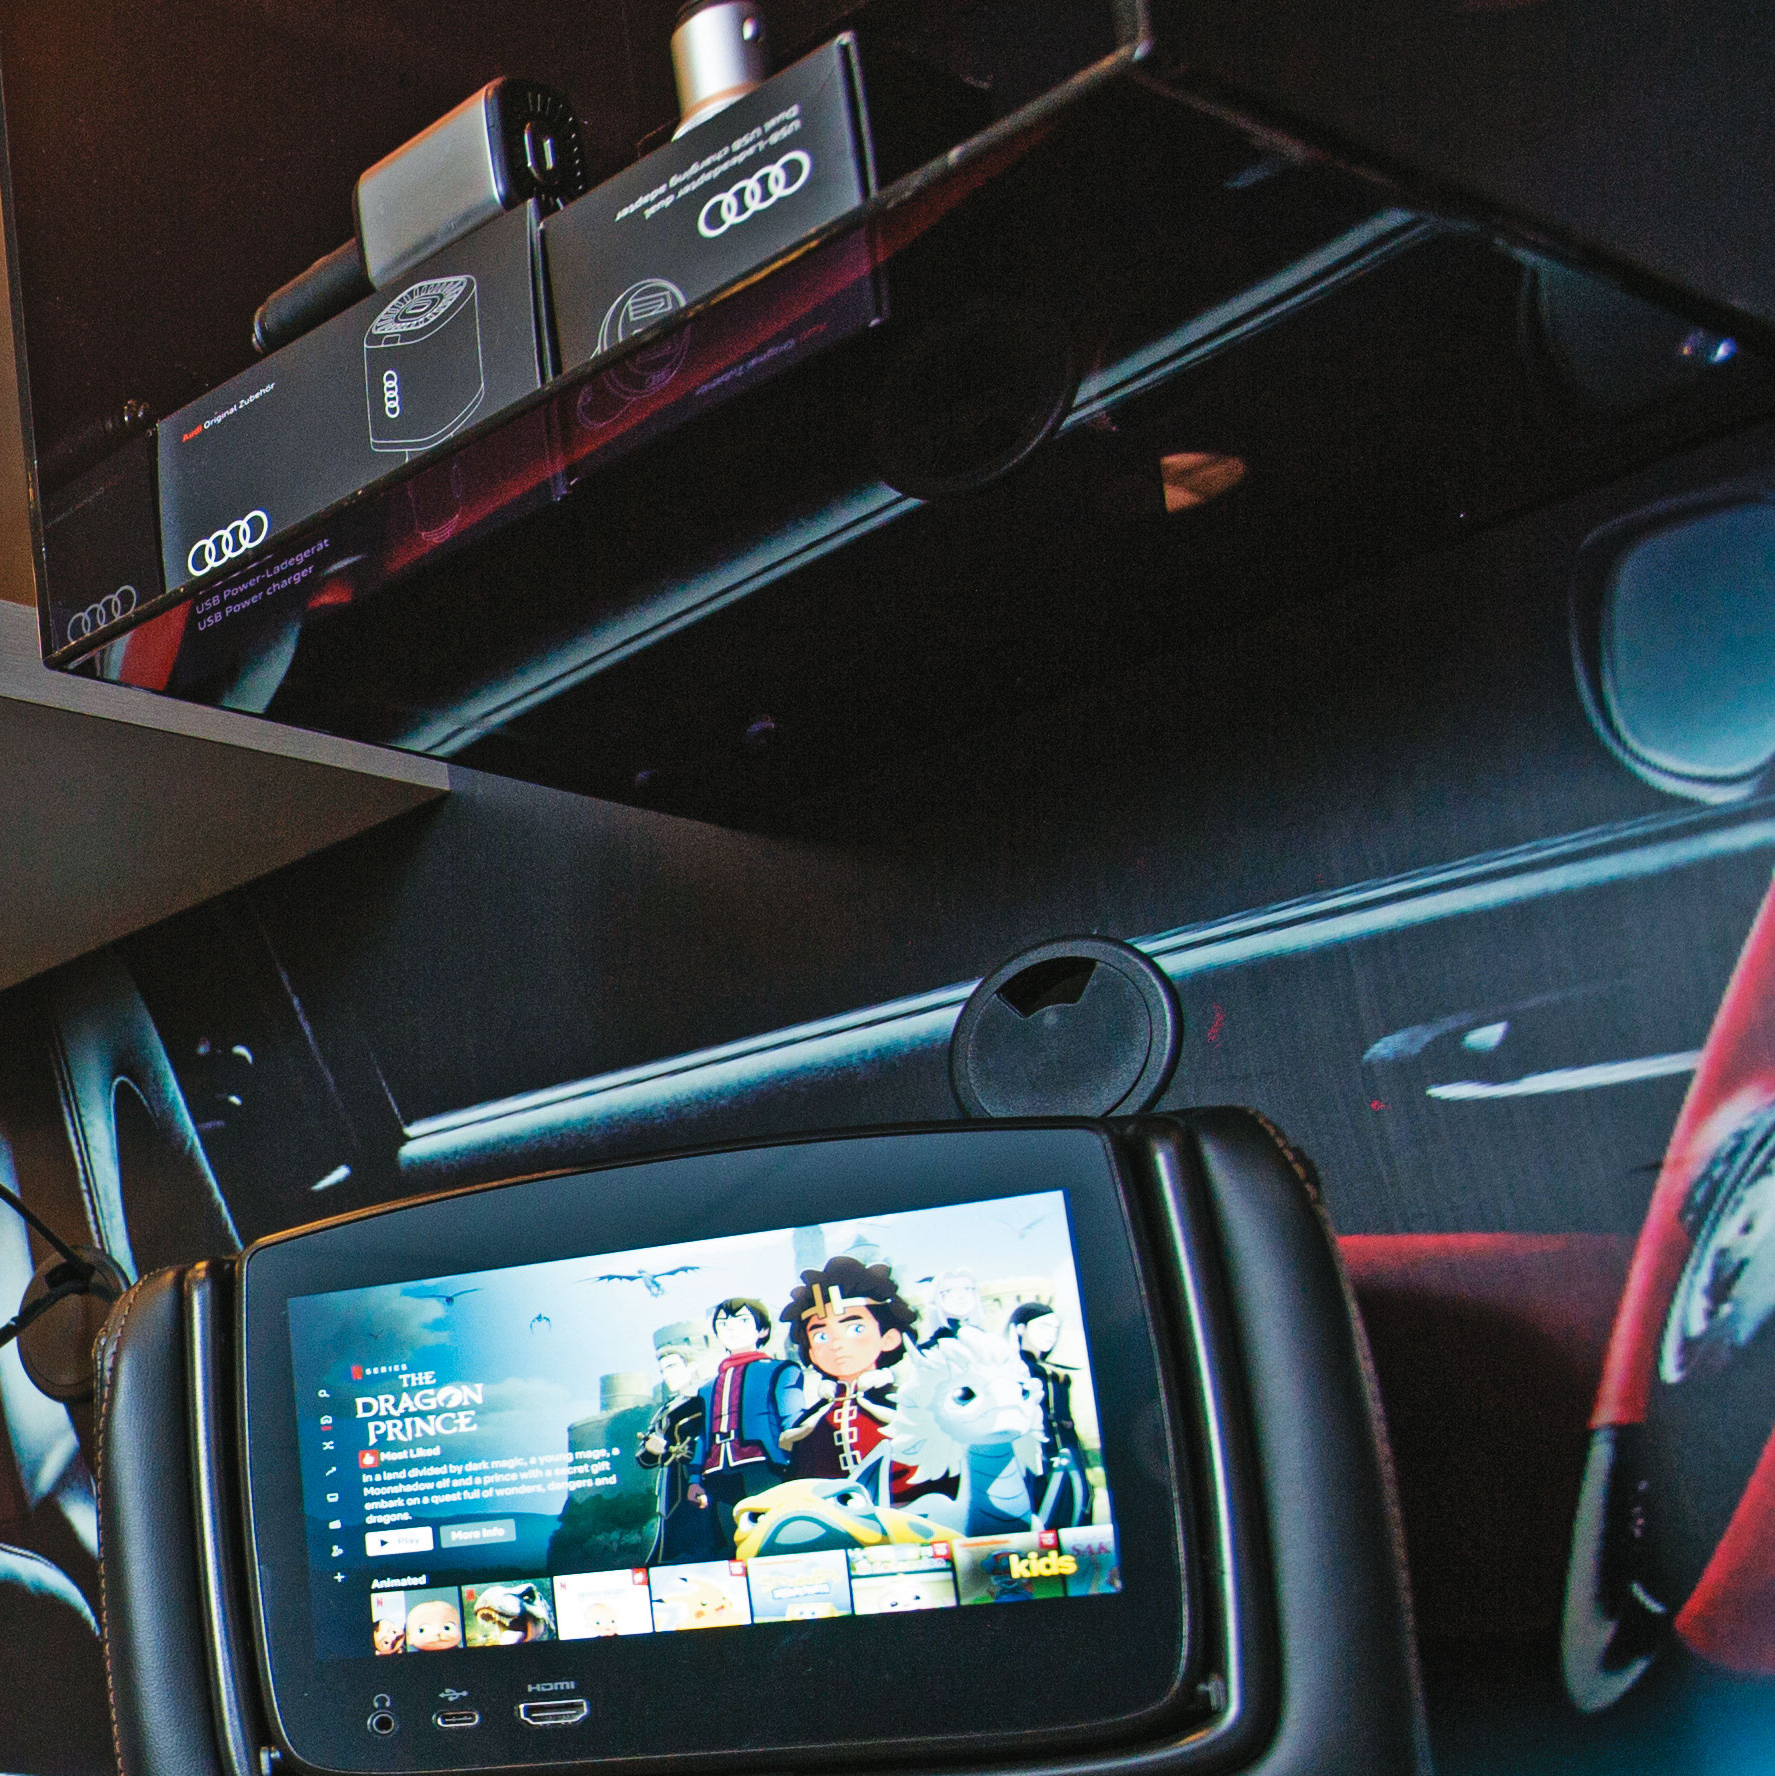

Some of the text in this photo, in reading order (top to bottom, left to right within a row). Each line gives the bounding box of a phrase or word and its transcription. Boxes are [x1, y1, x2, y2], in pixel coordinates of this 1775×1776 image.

[731, 126, 763, 152] USB
[203, 404, 239, 429] Original
[195, 537, 331, 615] USB Power-Ladegerät
[197, 564, 315, 631] USB Power charger
[398, 1371, 437, 1388] THE
[354, 1383, 485, 1419] DRAGON
[367, 1410, 479, 1447] PRINCE
[374, 1473, 382, 1482] a
[382, 1468, 407, 1481] land
[407, 1464, 448, 1478] divided
[448, 1463, 464, 1475] by
[464, 1460, 490, 1472] dark
[490, 1456, 528, 1470] magic,
[529, 1456, 537, 1465] a
[538, 1451, 574, 1466] young
[380, 1445, 441, 1462] Most Liked
[363, 1460, 611, 1497] Moonshadow elf and a prince with a secret gift
[364, 1473, 617, 1511] embark on a quest full of wonders, dangers and
[365, 1511, 413, 1525] dragons.
[451, 1526, 506, 1541] More Info
[1009, 1549, 1079, 1579] kids
[371, 1573, 428, 1590] Animated
[527, 1680, 576, 1693] HDMI
